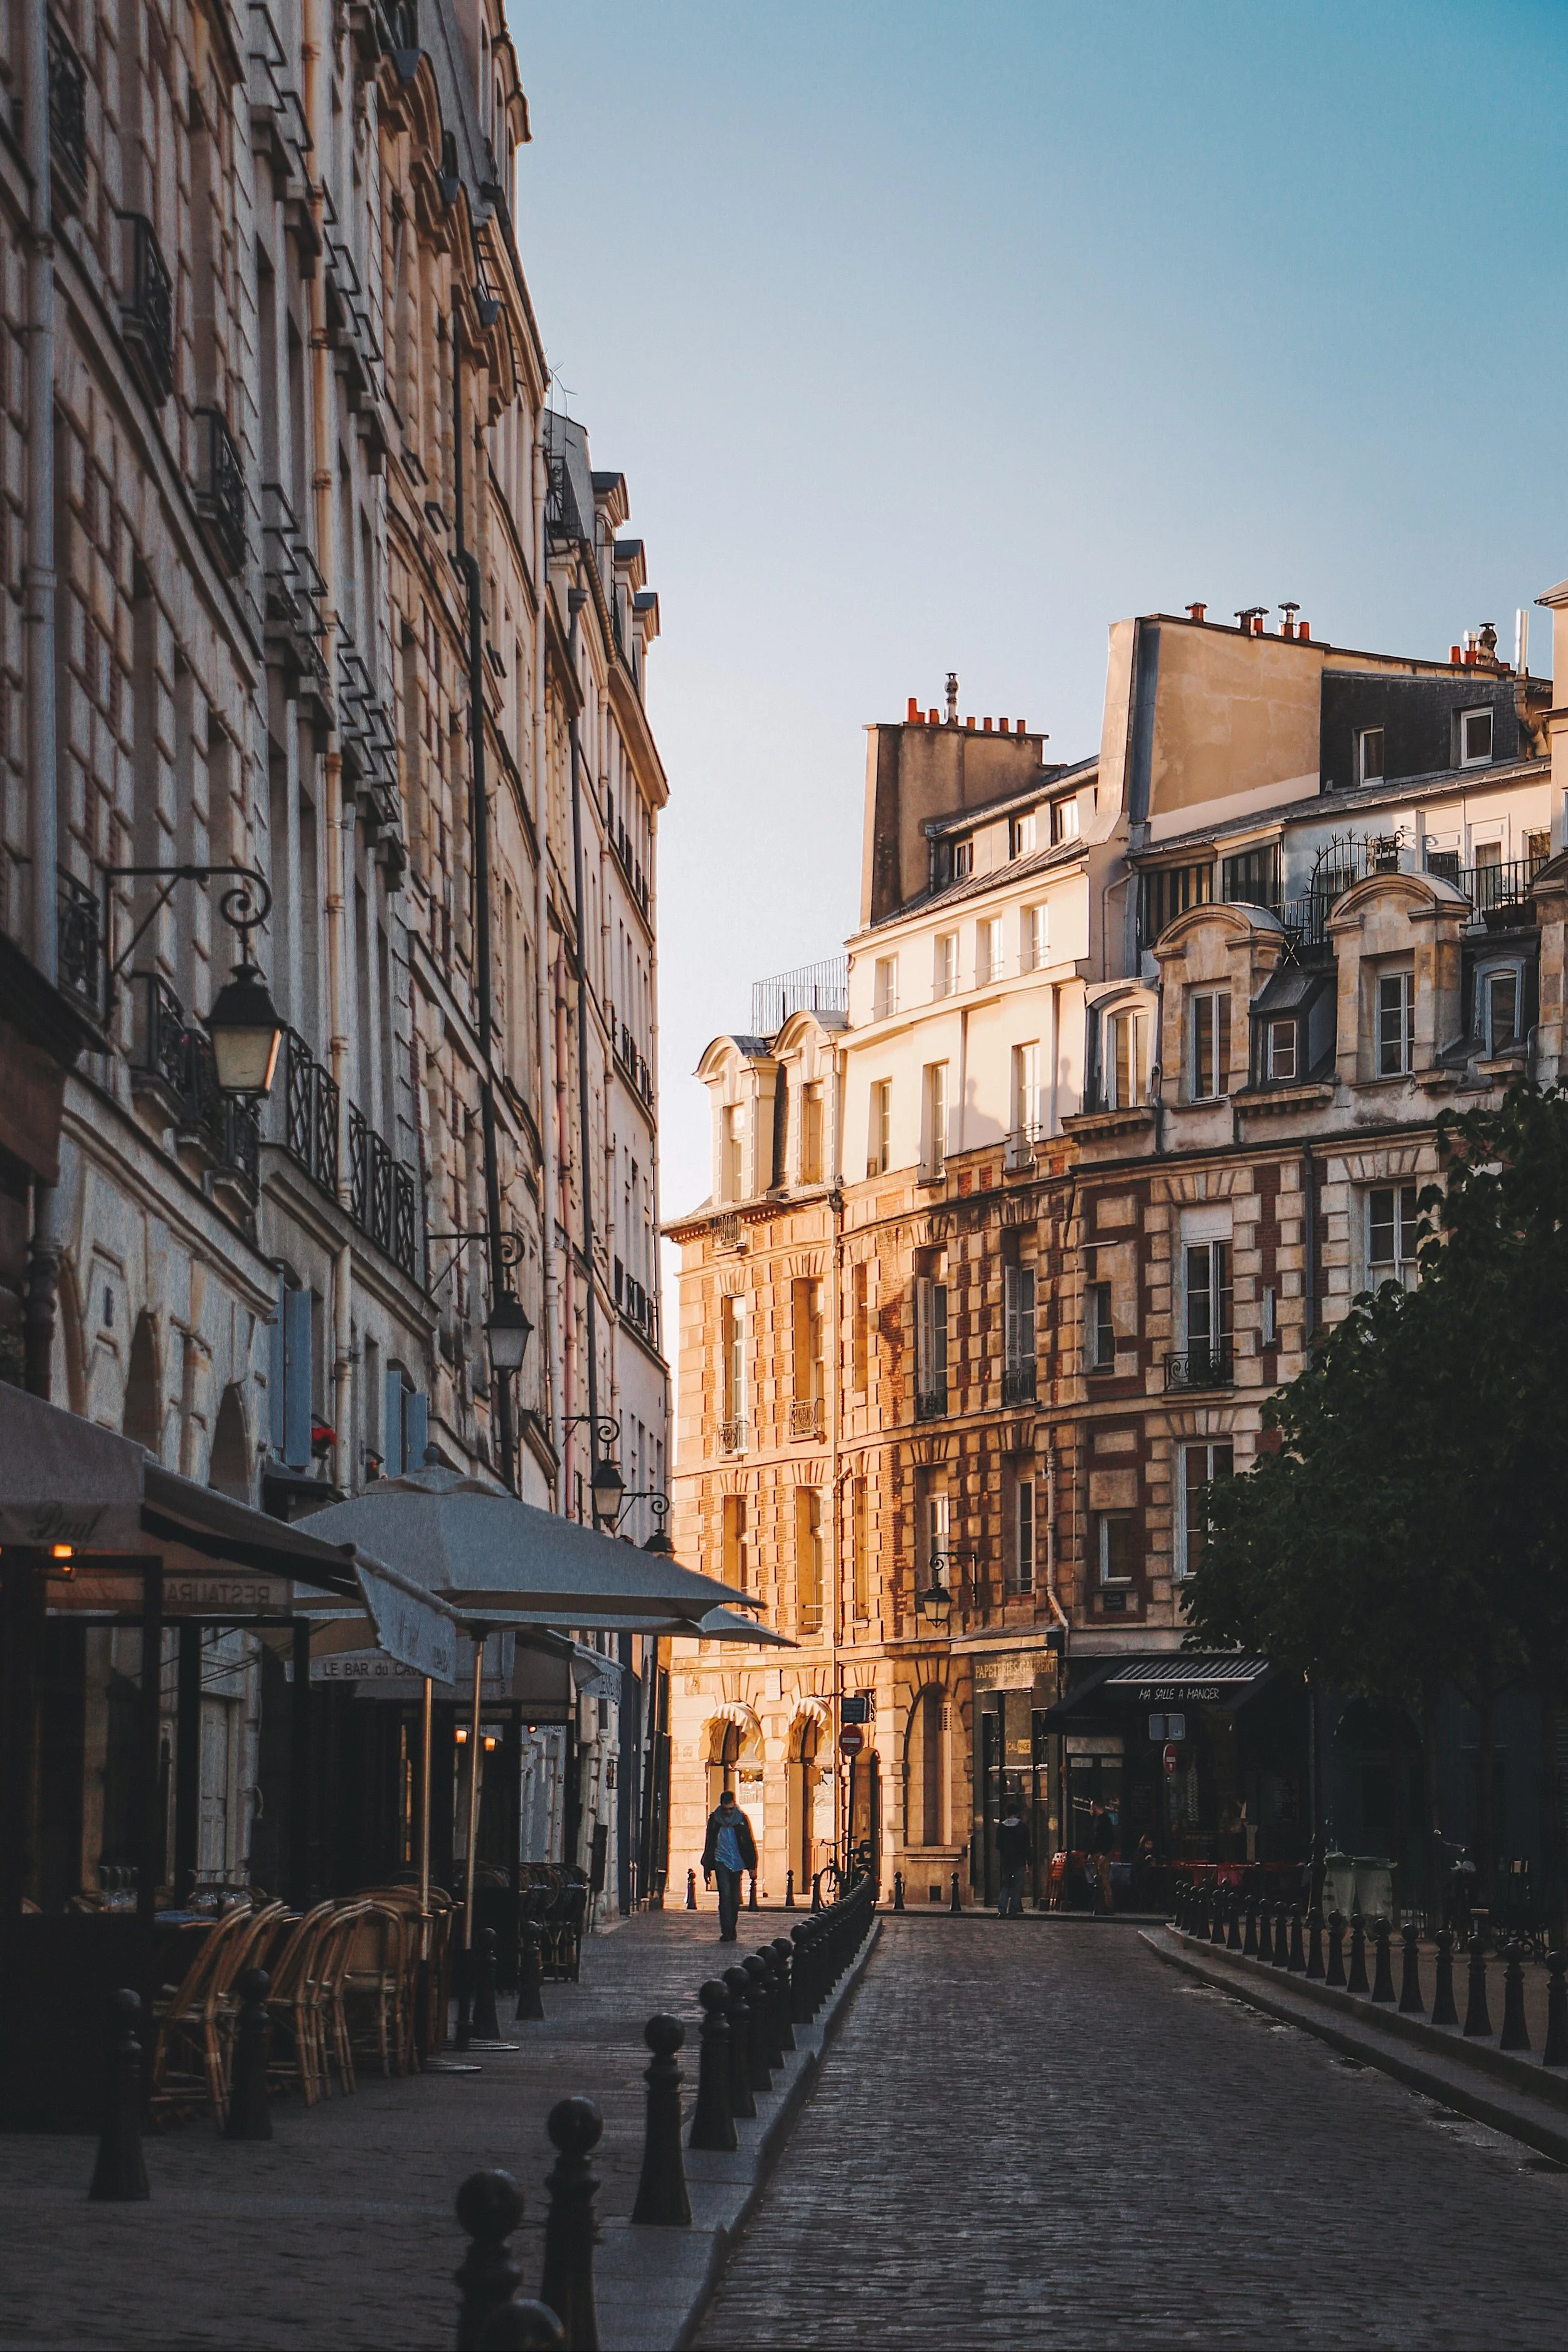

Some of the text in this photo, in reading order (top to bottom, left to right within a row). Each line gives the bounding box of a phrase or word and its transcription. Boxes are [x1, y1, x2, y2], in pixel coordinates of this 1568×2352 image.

[324, 1663, 339, 1677] LE
[345, 1663, 369, 1677] BAR
[376, 1663, 388, 1676] du
[1139, 1688, 1151, 1700] MA
[1155, 1688, 1175, 1700] SALLE
[1187, 1687, 1220, 1700] MANGER
